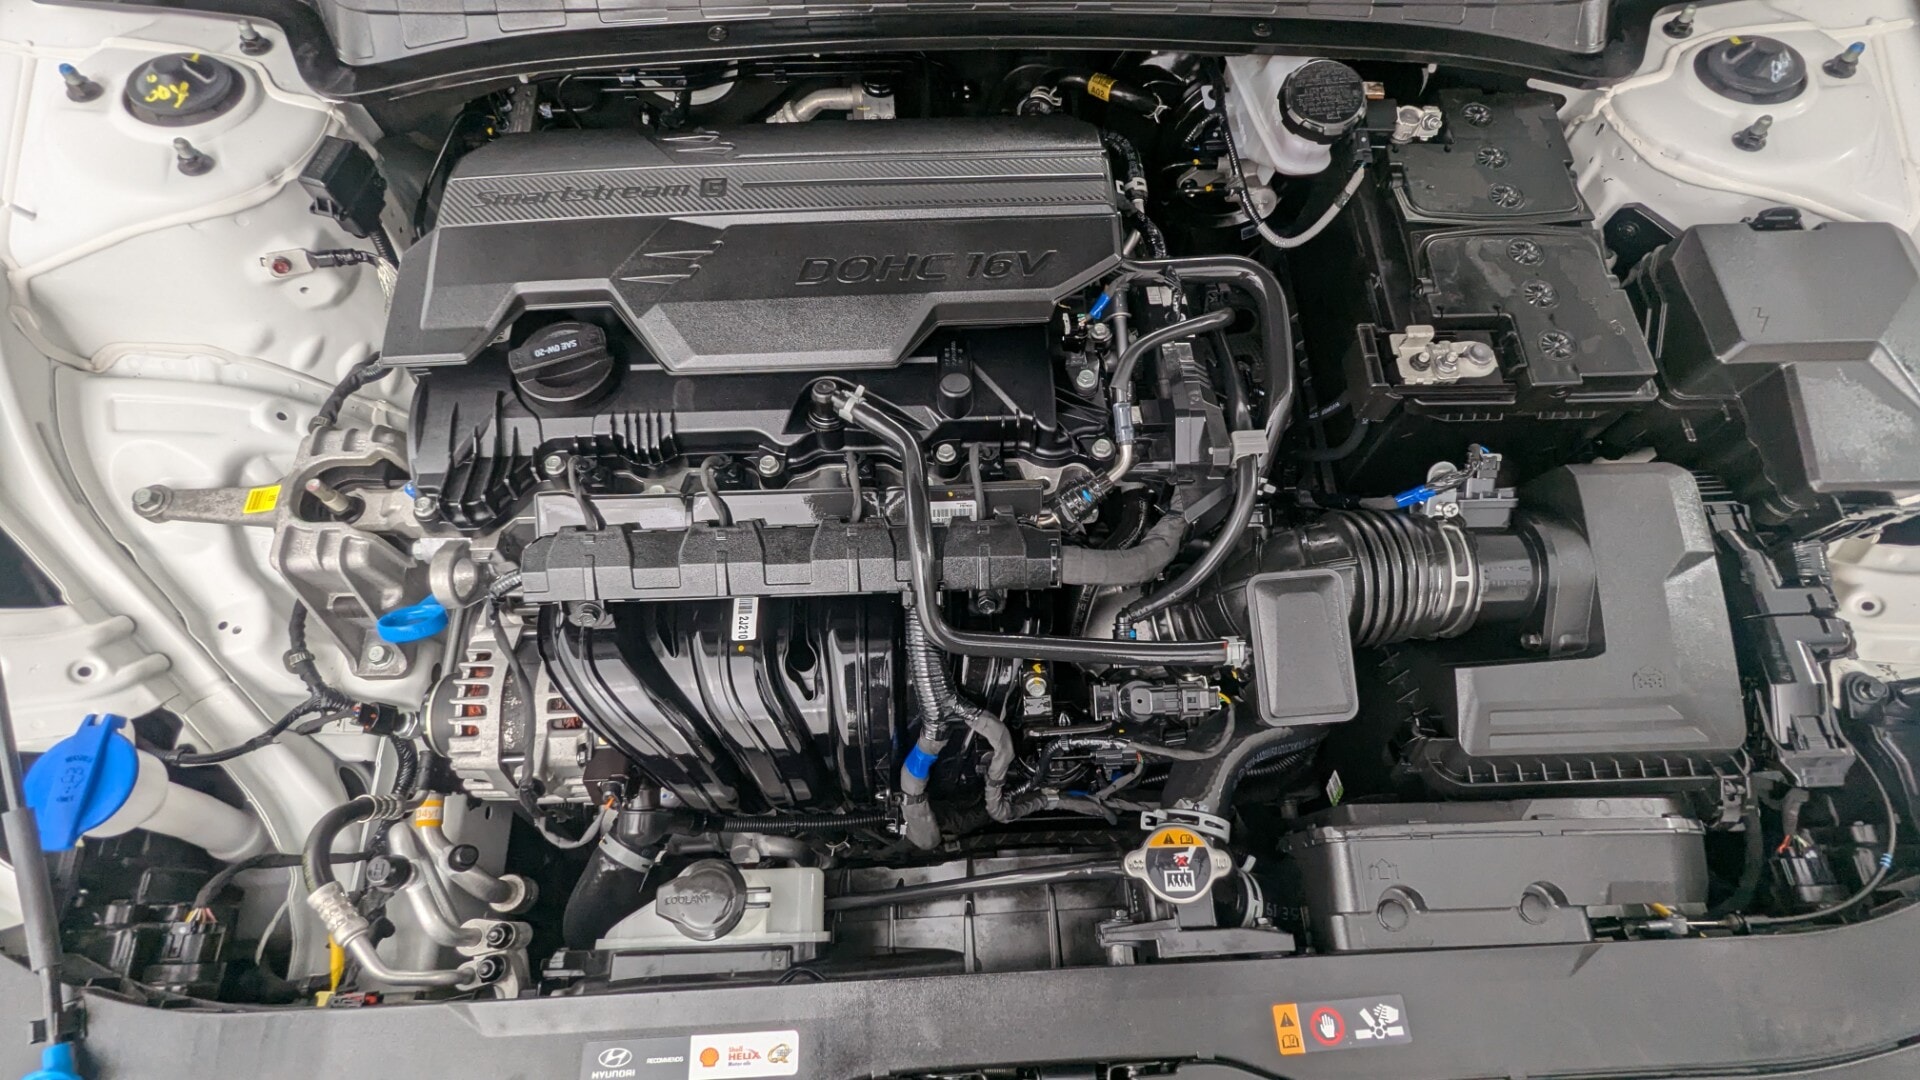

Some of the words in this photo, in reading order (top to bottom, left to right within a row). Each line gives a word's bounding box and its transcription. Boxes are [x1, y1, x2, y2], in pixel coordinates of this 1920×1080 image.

[471, 184, 691, 208] Smartstream
[795, 253, 955, 285] DOHC
[967, 250, 1057, 280] 16V
[534, 344, 561, 358] 0W-20
[561, 340, 578, 351] SAE
[737, 615, 750, 640] 2J210
[664, 894, 711, 906] COOLANT
[728, 1051, 762, 1061] HELIX
[591, 1069, 636, 1080] HYUNDAI
